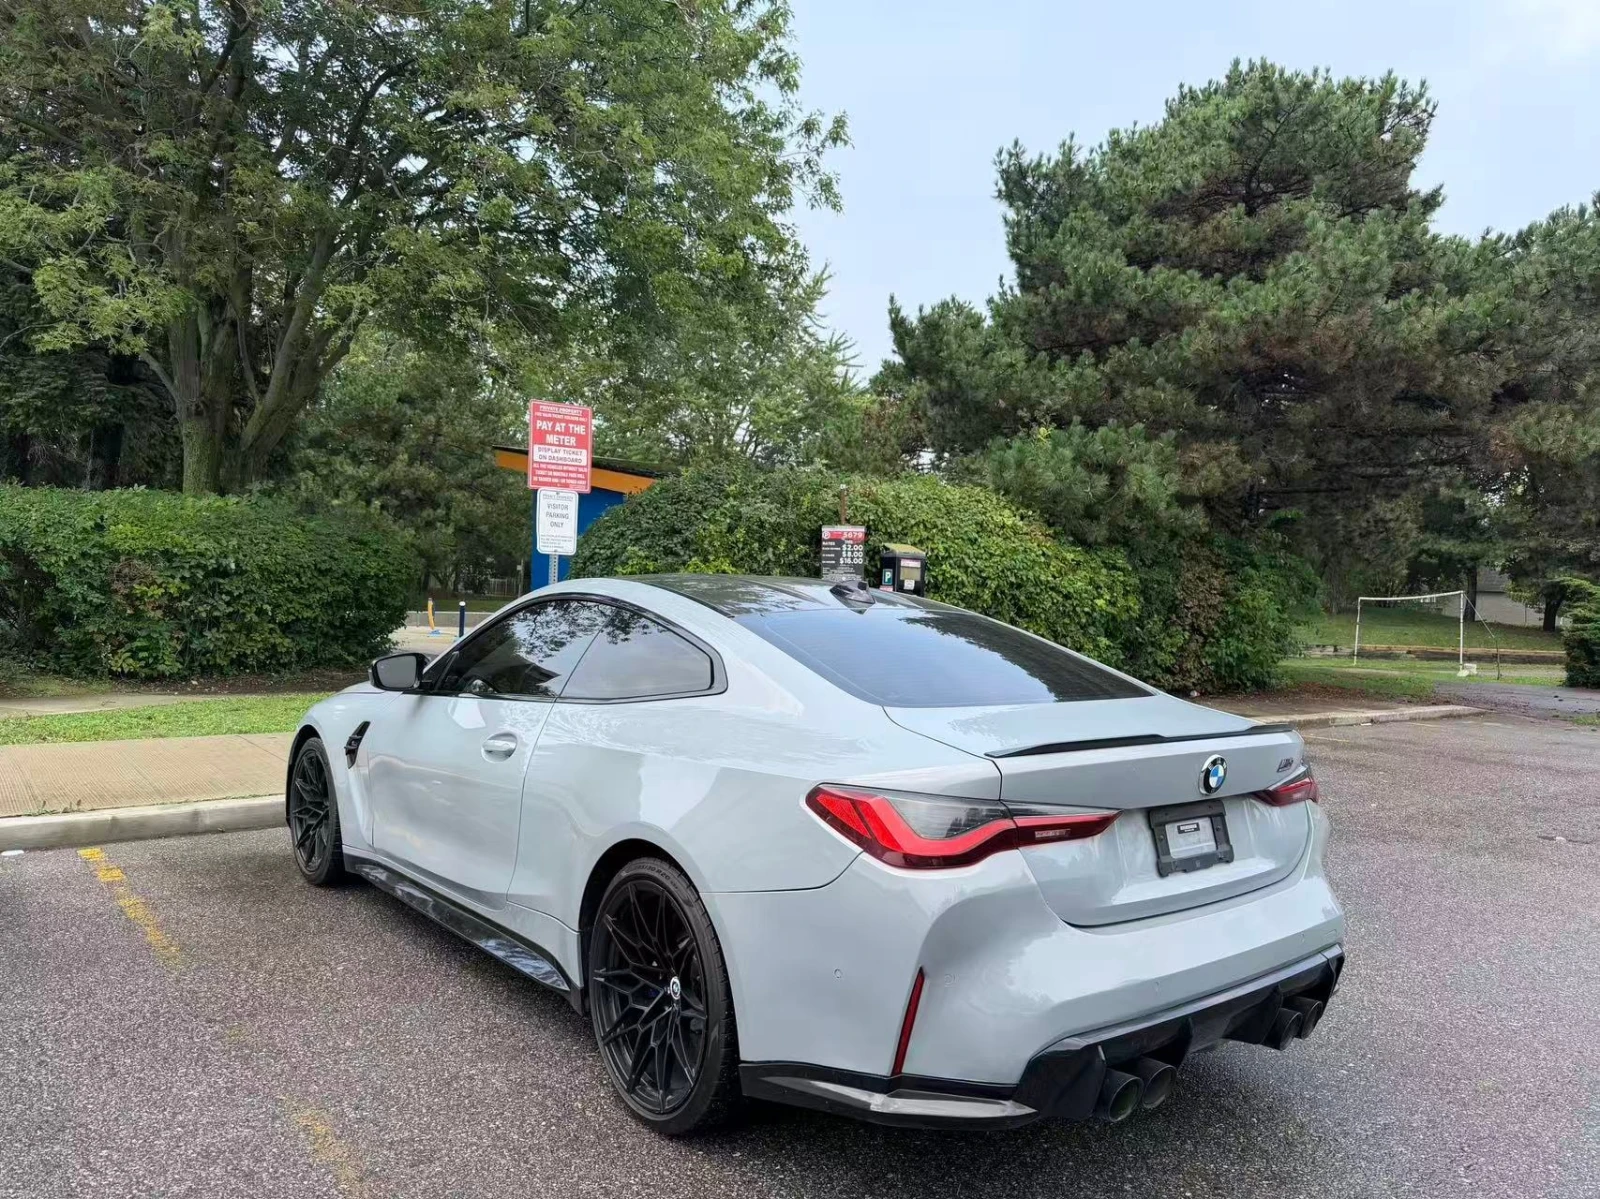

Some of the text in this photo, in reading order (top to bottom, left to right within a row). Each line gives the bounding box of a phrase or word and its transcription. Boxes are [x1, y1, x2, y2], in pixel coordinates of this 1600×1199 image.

[536, 420, 586, 435] PAY AT THE
[545, 434, 576, 446] METER
[548, 455, 582, 464] DASHBOARD
[885, 571, 891, 583] P
